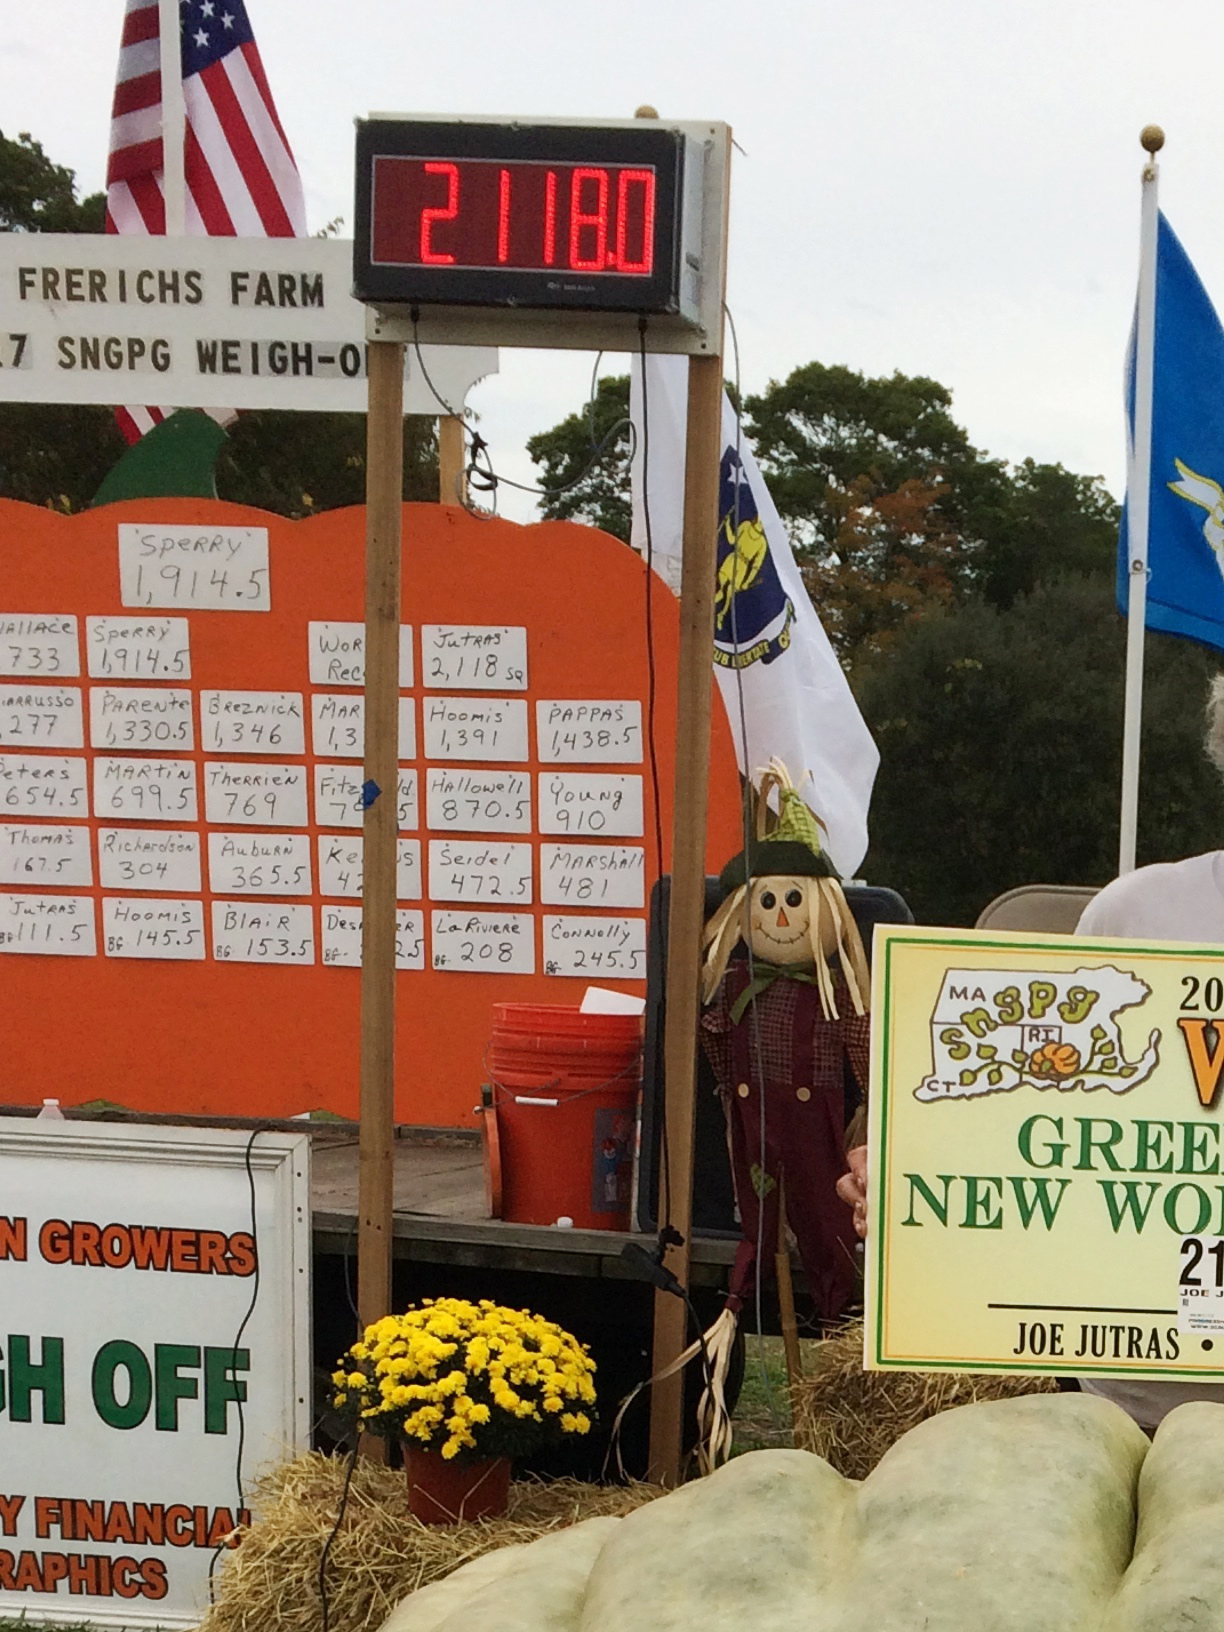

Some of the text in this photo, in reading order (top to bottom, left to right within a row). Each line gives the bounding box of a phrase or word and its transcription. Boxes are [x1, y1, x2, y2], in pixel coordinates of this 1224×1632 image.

[18, 266, 325, 308] FRERICHS FARM
[57, 334, 173, 373] SNGPG
[134, 564, 268, 605] 1,914.5
[101, 646, 186, 675] 1,914.5
[431, 653, 498, 682] 2,118
[105, 720, 191, 745] 1,330.5
[213, 722, 283, 748] 1,346
[440, 727, 498, 752] 1,391
[551, 725, 639, 757] 1,438.5
[110, 784, 194, 813] 699.5
[224, 792, 278, 820] 769
[442, 798, 531, 822] 870.5
[556, 809, 606, 832] 910
[118, 861, 168, 881] 304
[231, 865, 307, 889] 365.5
[450, 874, 532, 897] 472.5
[558, 877, 609, 899] 481
[136, 929, 201, 947] 145.5
[246, 938, 313, 957] 153.5
[460, 941, 514, 964] 208
[573, 949, 647, 970] 245.5
[949, 985, 987, 1001] MA
[900, 1173, 1073, 1235] NEW
[38, 1217, 257, 1278] GROWERS
[1180, 1288, 1210, 1298] JOE
[1013, 1322, 1065, 1357] JOE
[1074, 1324, 1181, 1361] JUTRAS
[90, 1337, 251, 1436] OFF
